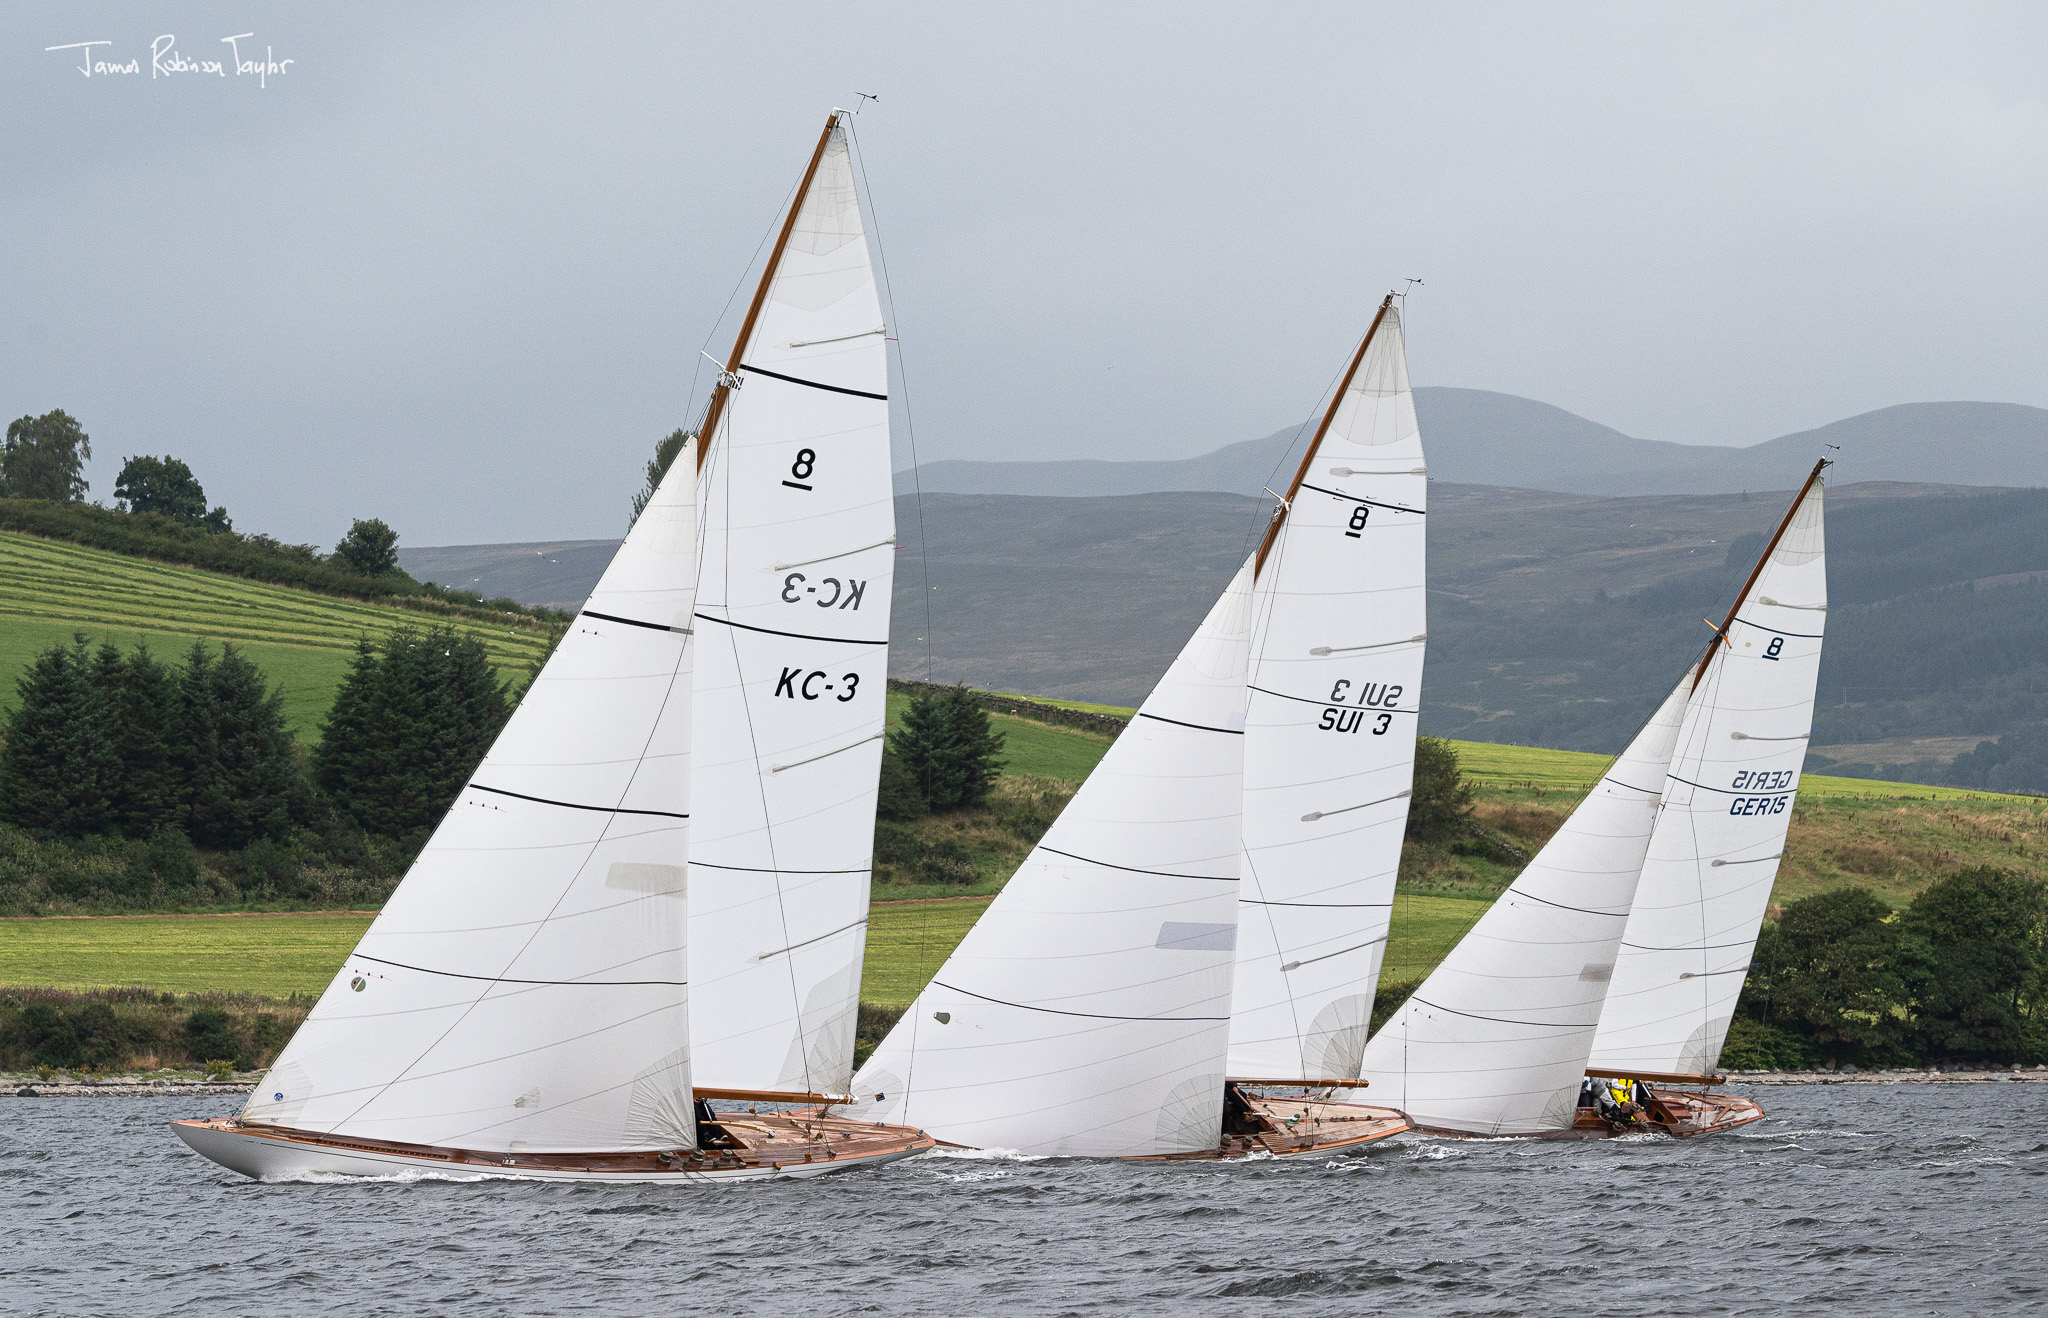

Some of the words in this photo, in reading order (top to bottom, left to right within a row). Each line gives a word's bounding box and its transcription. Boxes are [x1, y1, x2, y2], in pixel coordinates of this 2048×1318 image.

[791, 448, 816, 479] 8
[1349, 506, 1370, 531] 8
[1766, 636, 1785, 657] 8
[774, 666, 860, 703] KC-3
[1318, 707, 1365, 734] SUI
[1372, 713, 1393, 736] 3
[1729, 795, 1789, 816] GER15
